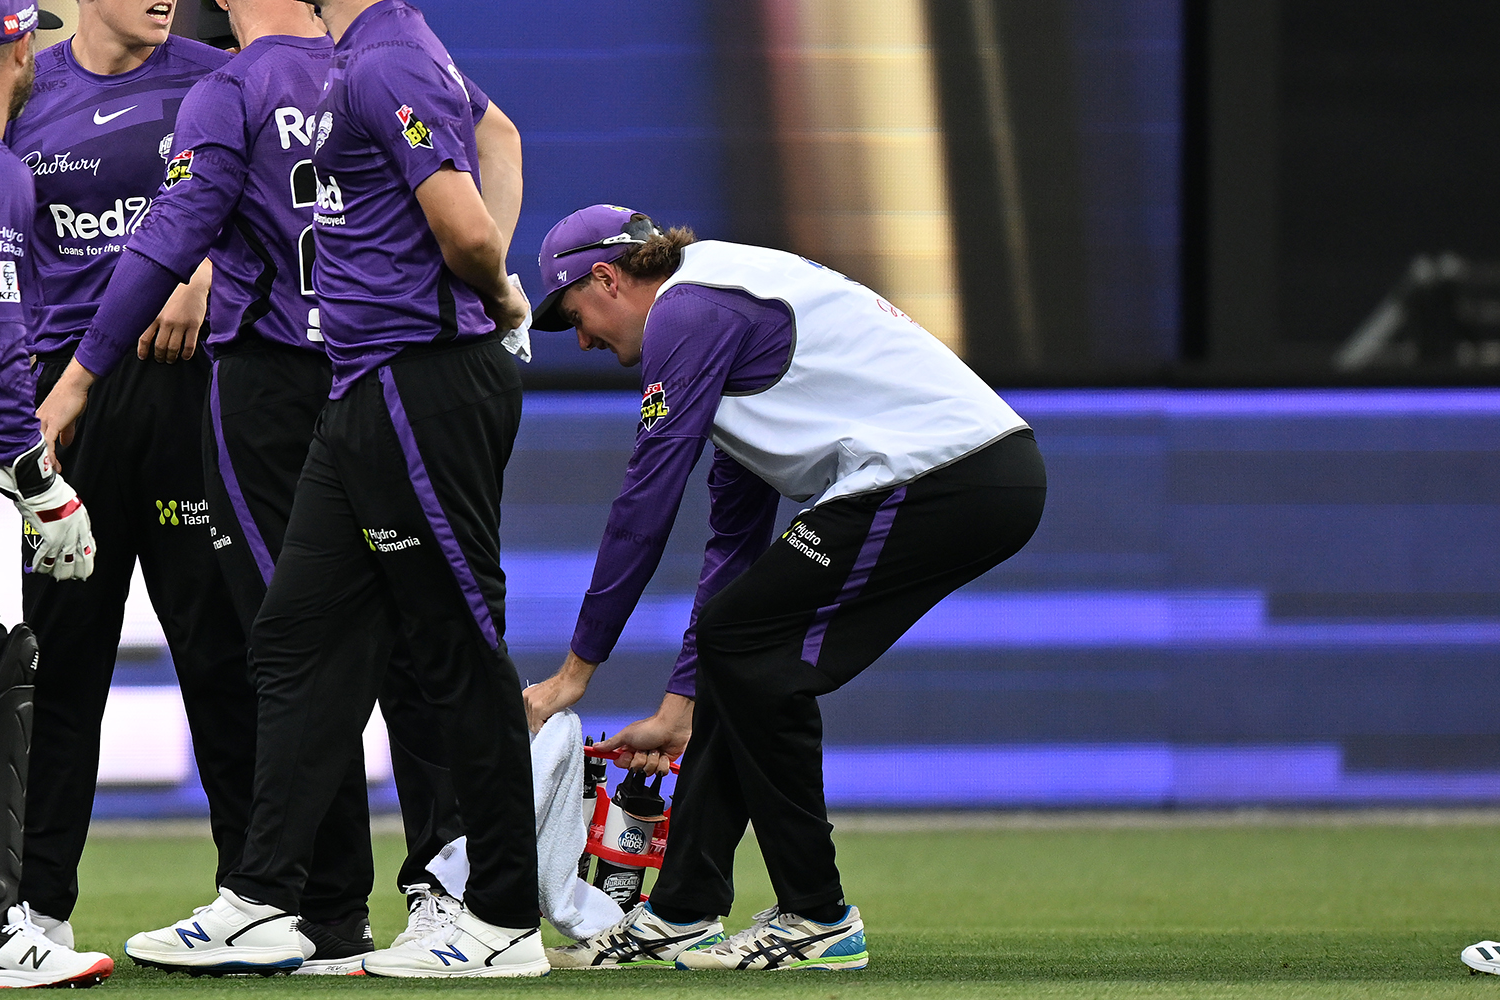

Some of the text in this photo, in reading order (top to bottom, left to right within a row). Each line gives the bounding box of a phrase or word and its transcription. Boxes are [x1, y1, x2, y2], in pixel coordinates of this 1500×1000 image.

[405, 120, 431, 146] BB
[58, 244, 84, 257] Loans
[86, 244, 102, 256] for
[103, 242, 119, 253] the
[368, 528, 398, 543] Hydro
[794, 522, 822, 546] Hydro
[786, 533, 831, 567] Tasmania
[625, 831, 642, 841] COOL
[621, 838, 642, 850] RIDGE
